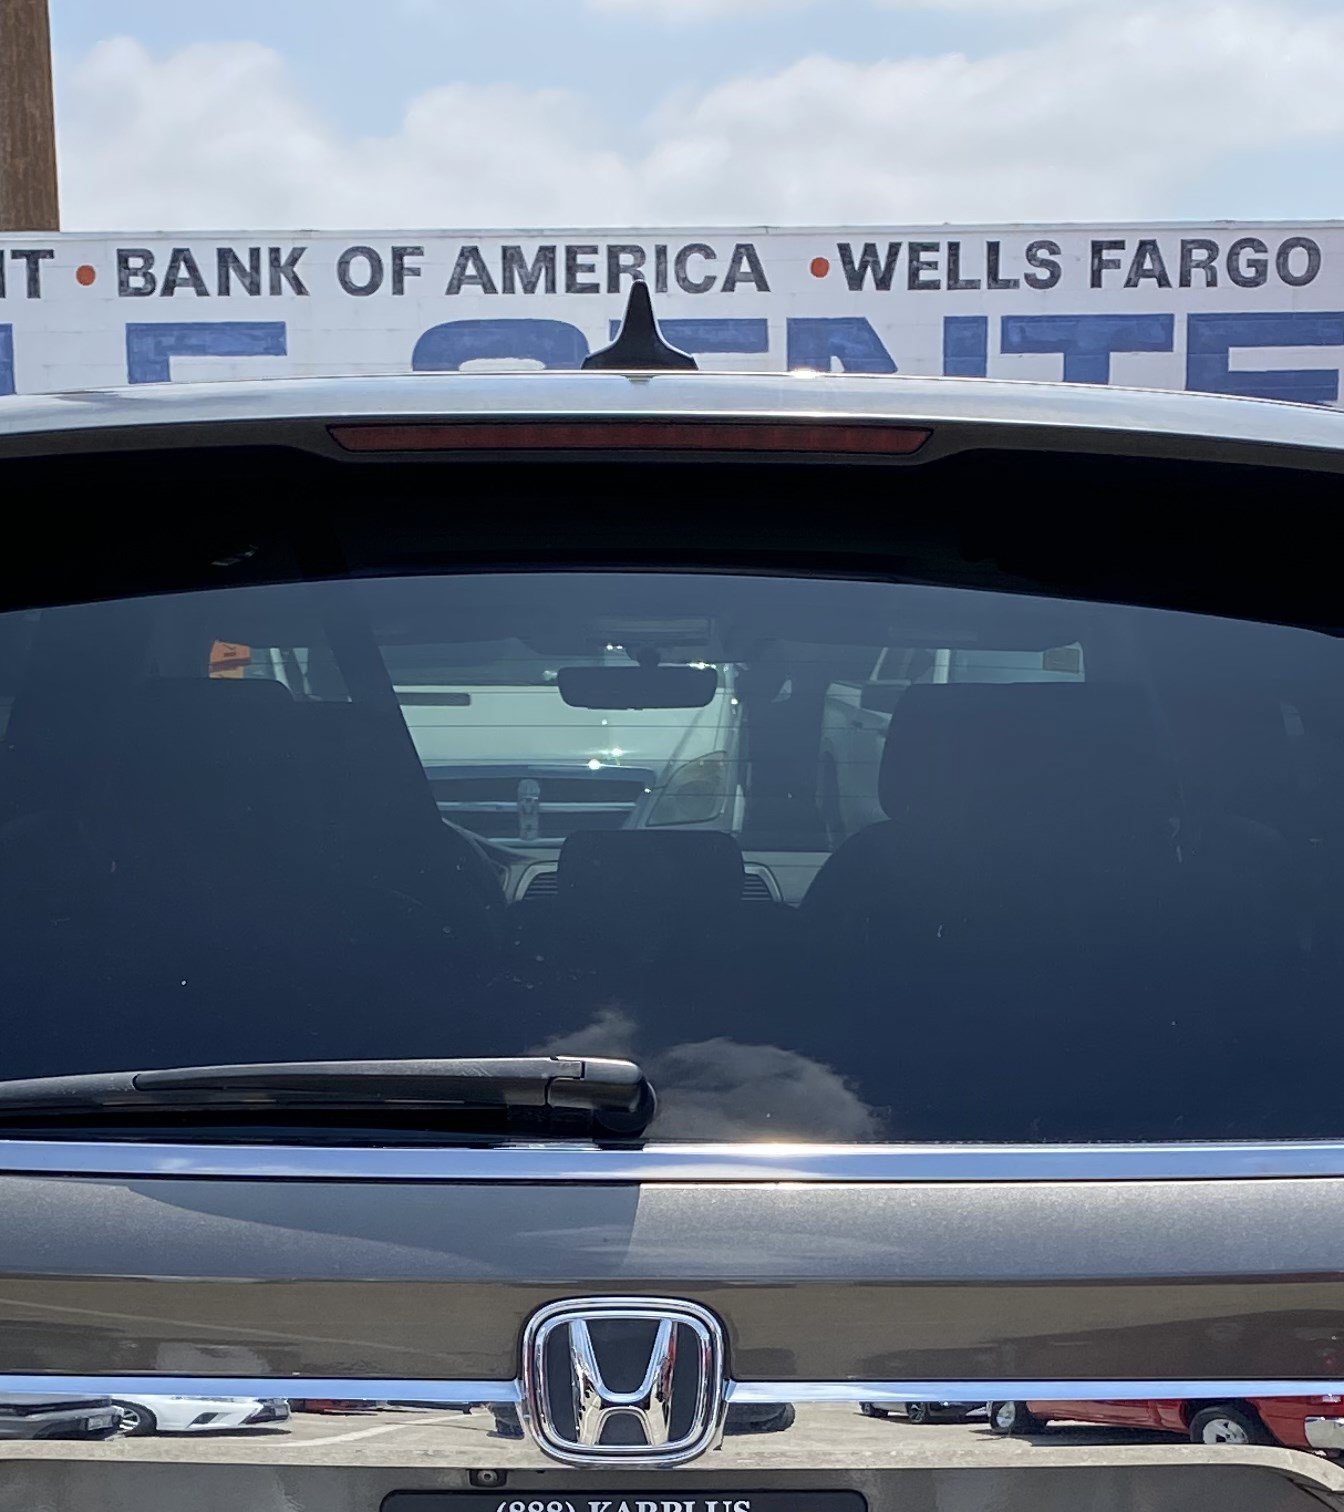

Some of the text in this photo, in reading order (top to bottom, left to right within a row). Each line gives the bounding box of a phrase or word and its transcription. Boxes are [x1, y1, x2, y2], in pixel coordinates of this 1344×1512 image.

[116, 246, 310, 297] BANK
[337, 245, 425, 296] OF
[444, 242, 772, 296] AMERICA
[836, 240, 1063, 292] WELLS
[1089, 235, 1322, 288] FARGO
